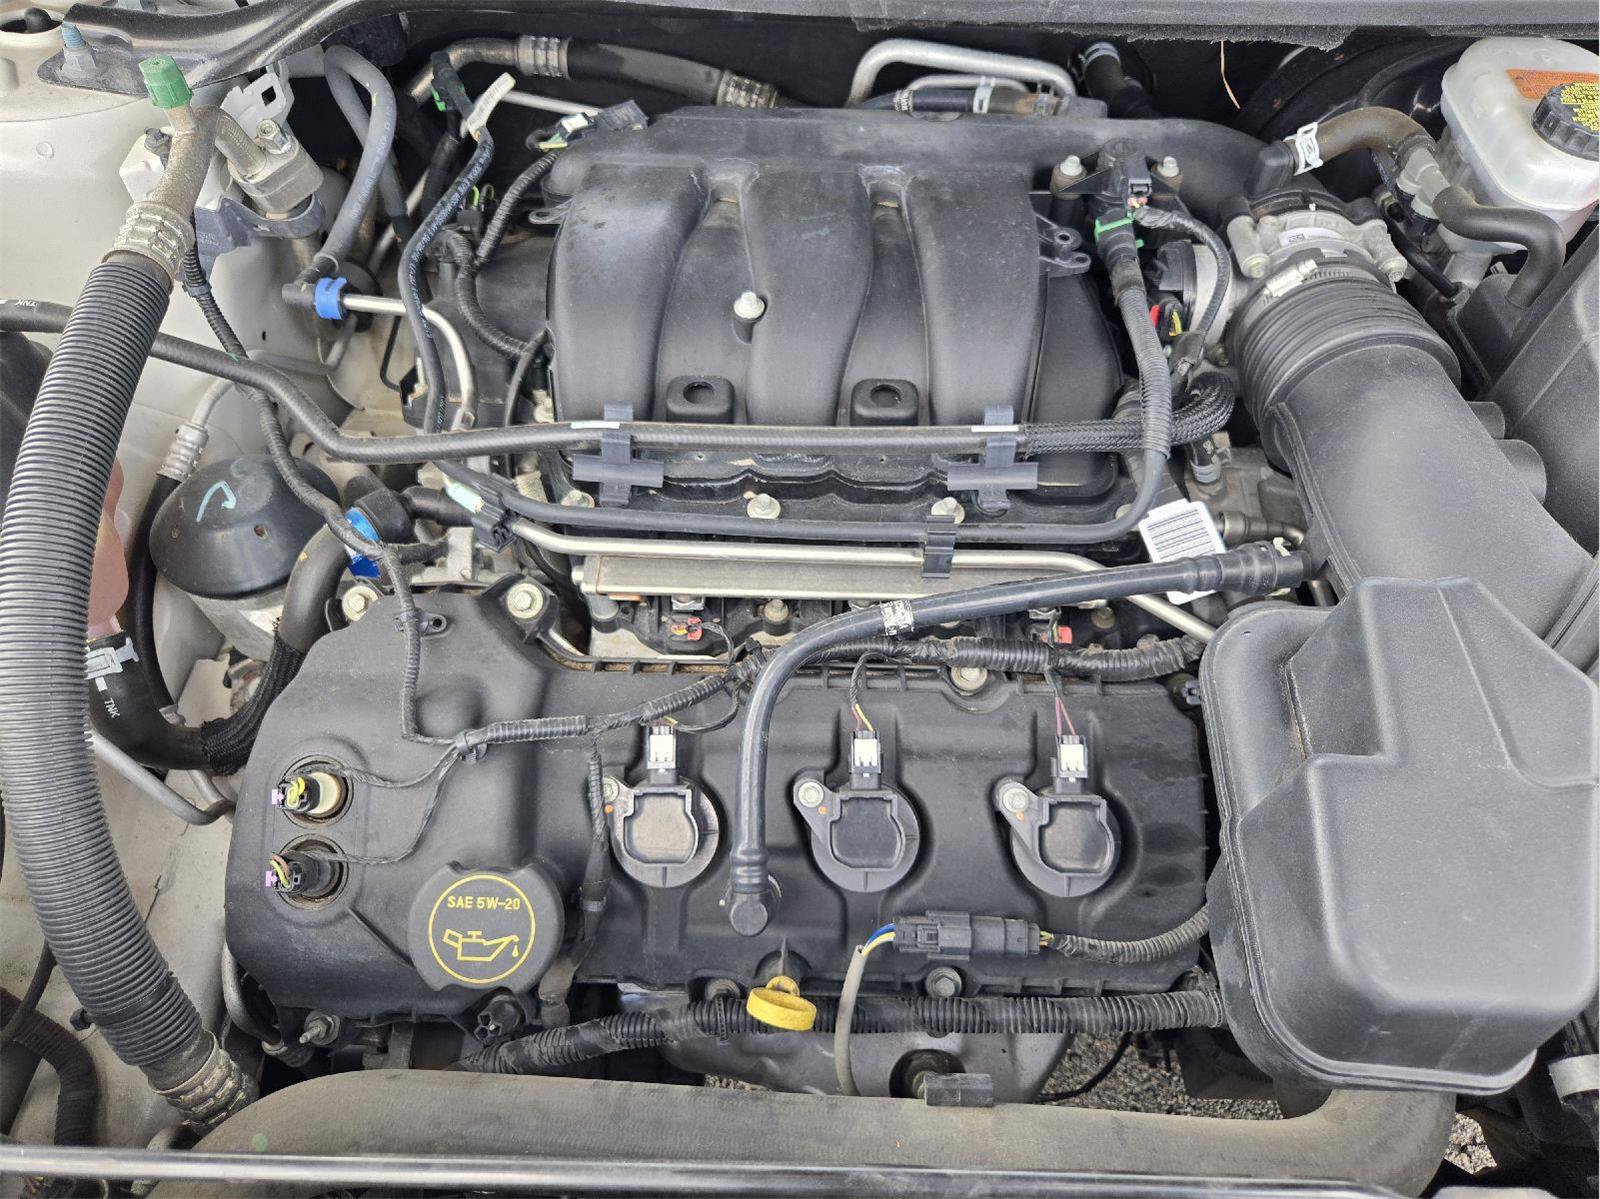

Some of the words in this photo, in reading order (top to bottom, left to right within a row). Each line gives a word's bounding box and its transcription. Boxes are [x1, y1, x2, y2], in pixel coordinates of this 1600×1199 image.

[104, 697, 120, 718] TNK
[447, 895, 474, 909] SAE
[476, 896, 521, 911] 5W-20
